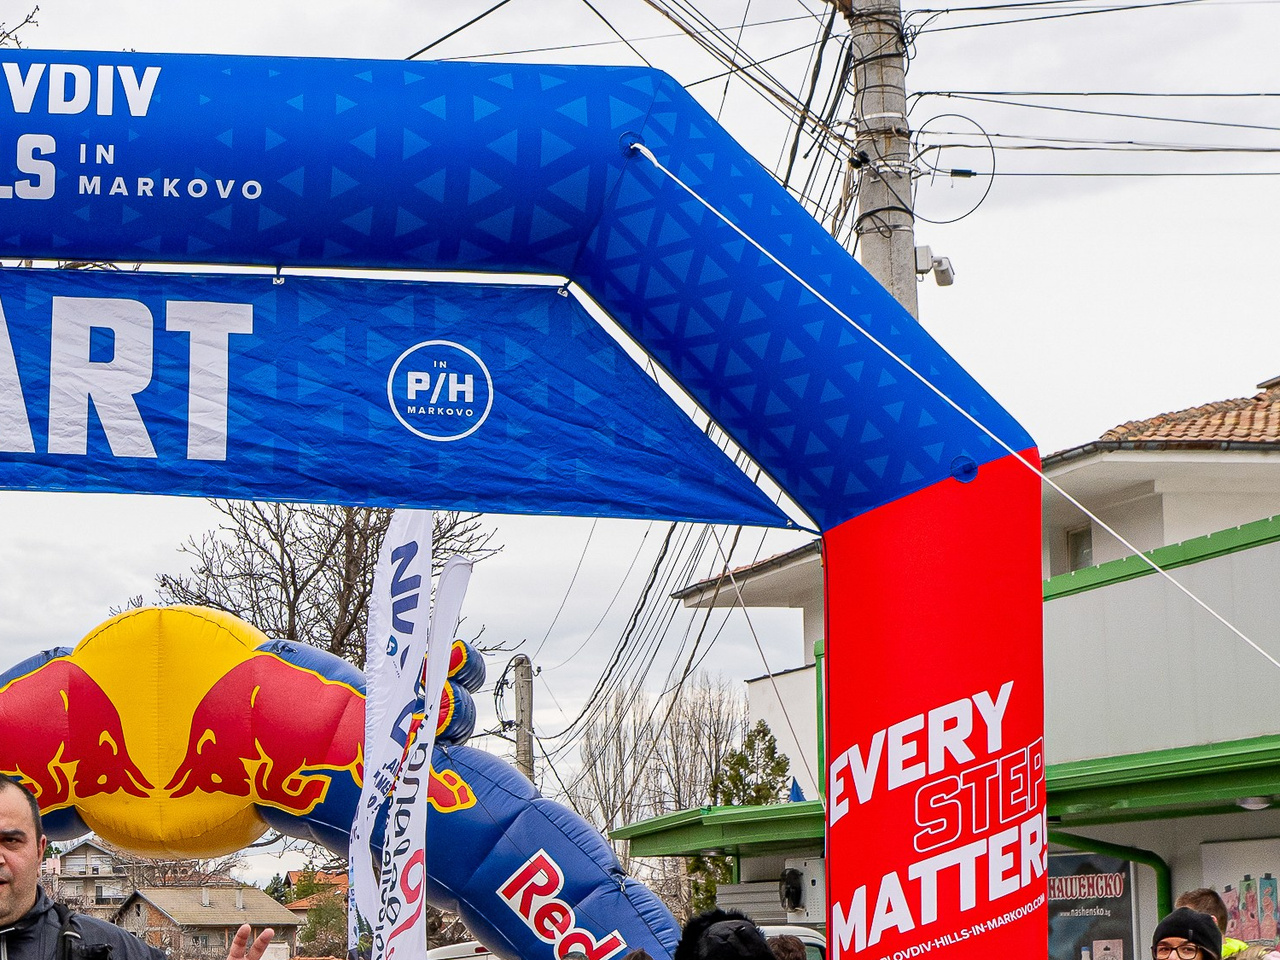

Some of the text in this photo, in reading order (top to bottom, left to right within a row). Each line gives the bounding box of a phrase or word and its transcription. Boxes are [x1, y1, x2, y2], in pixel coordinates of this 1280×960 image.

[78, 142, 115, 165] IN
[78, 174, 263, 200] MARKOVO
[433, 360, 447, 369] IN
[407, 371, 474, 404] P/H
[407, 406, 474, 417] MARKOVO
[829, 680, 1014, 828] EVERY
[913, 736, 1045, 853] STEP
